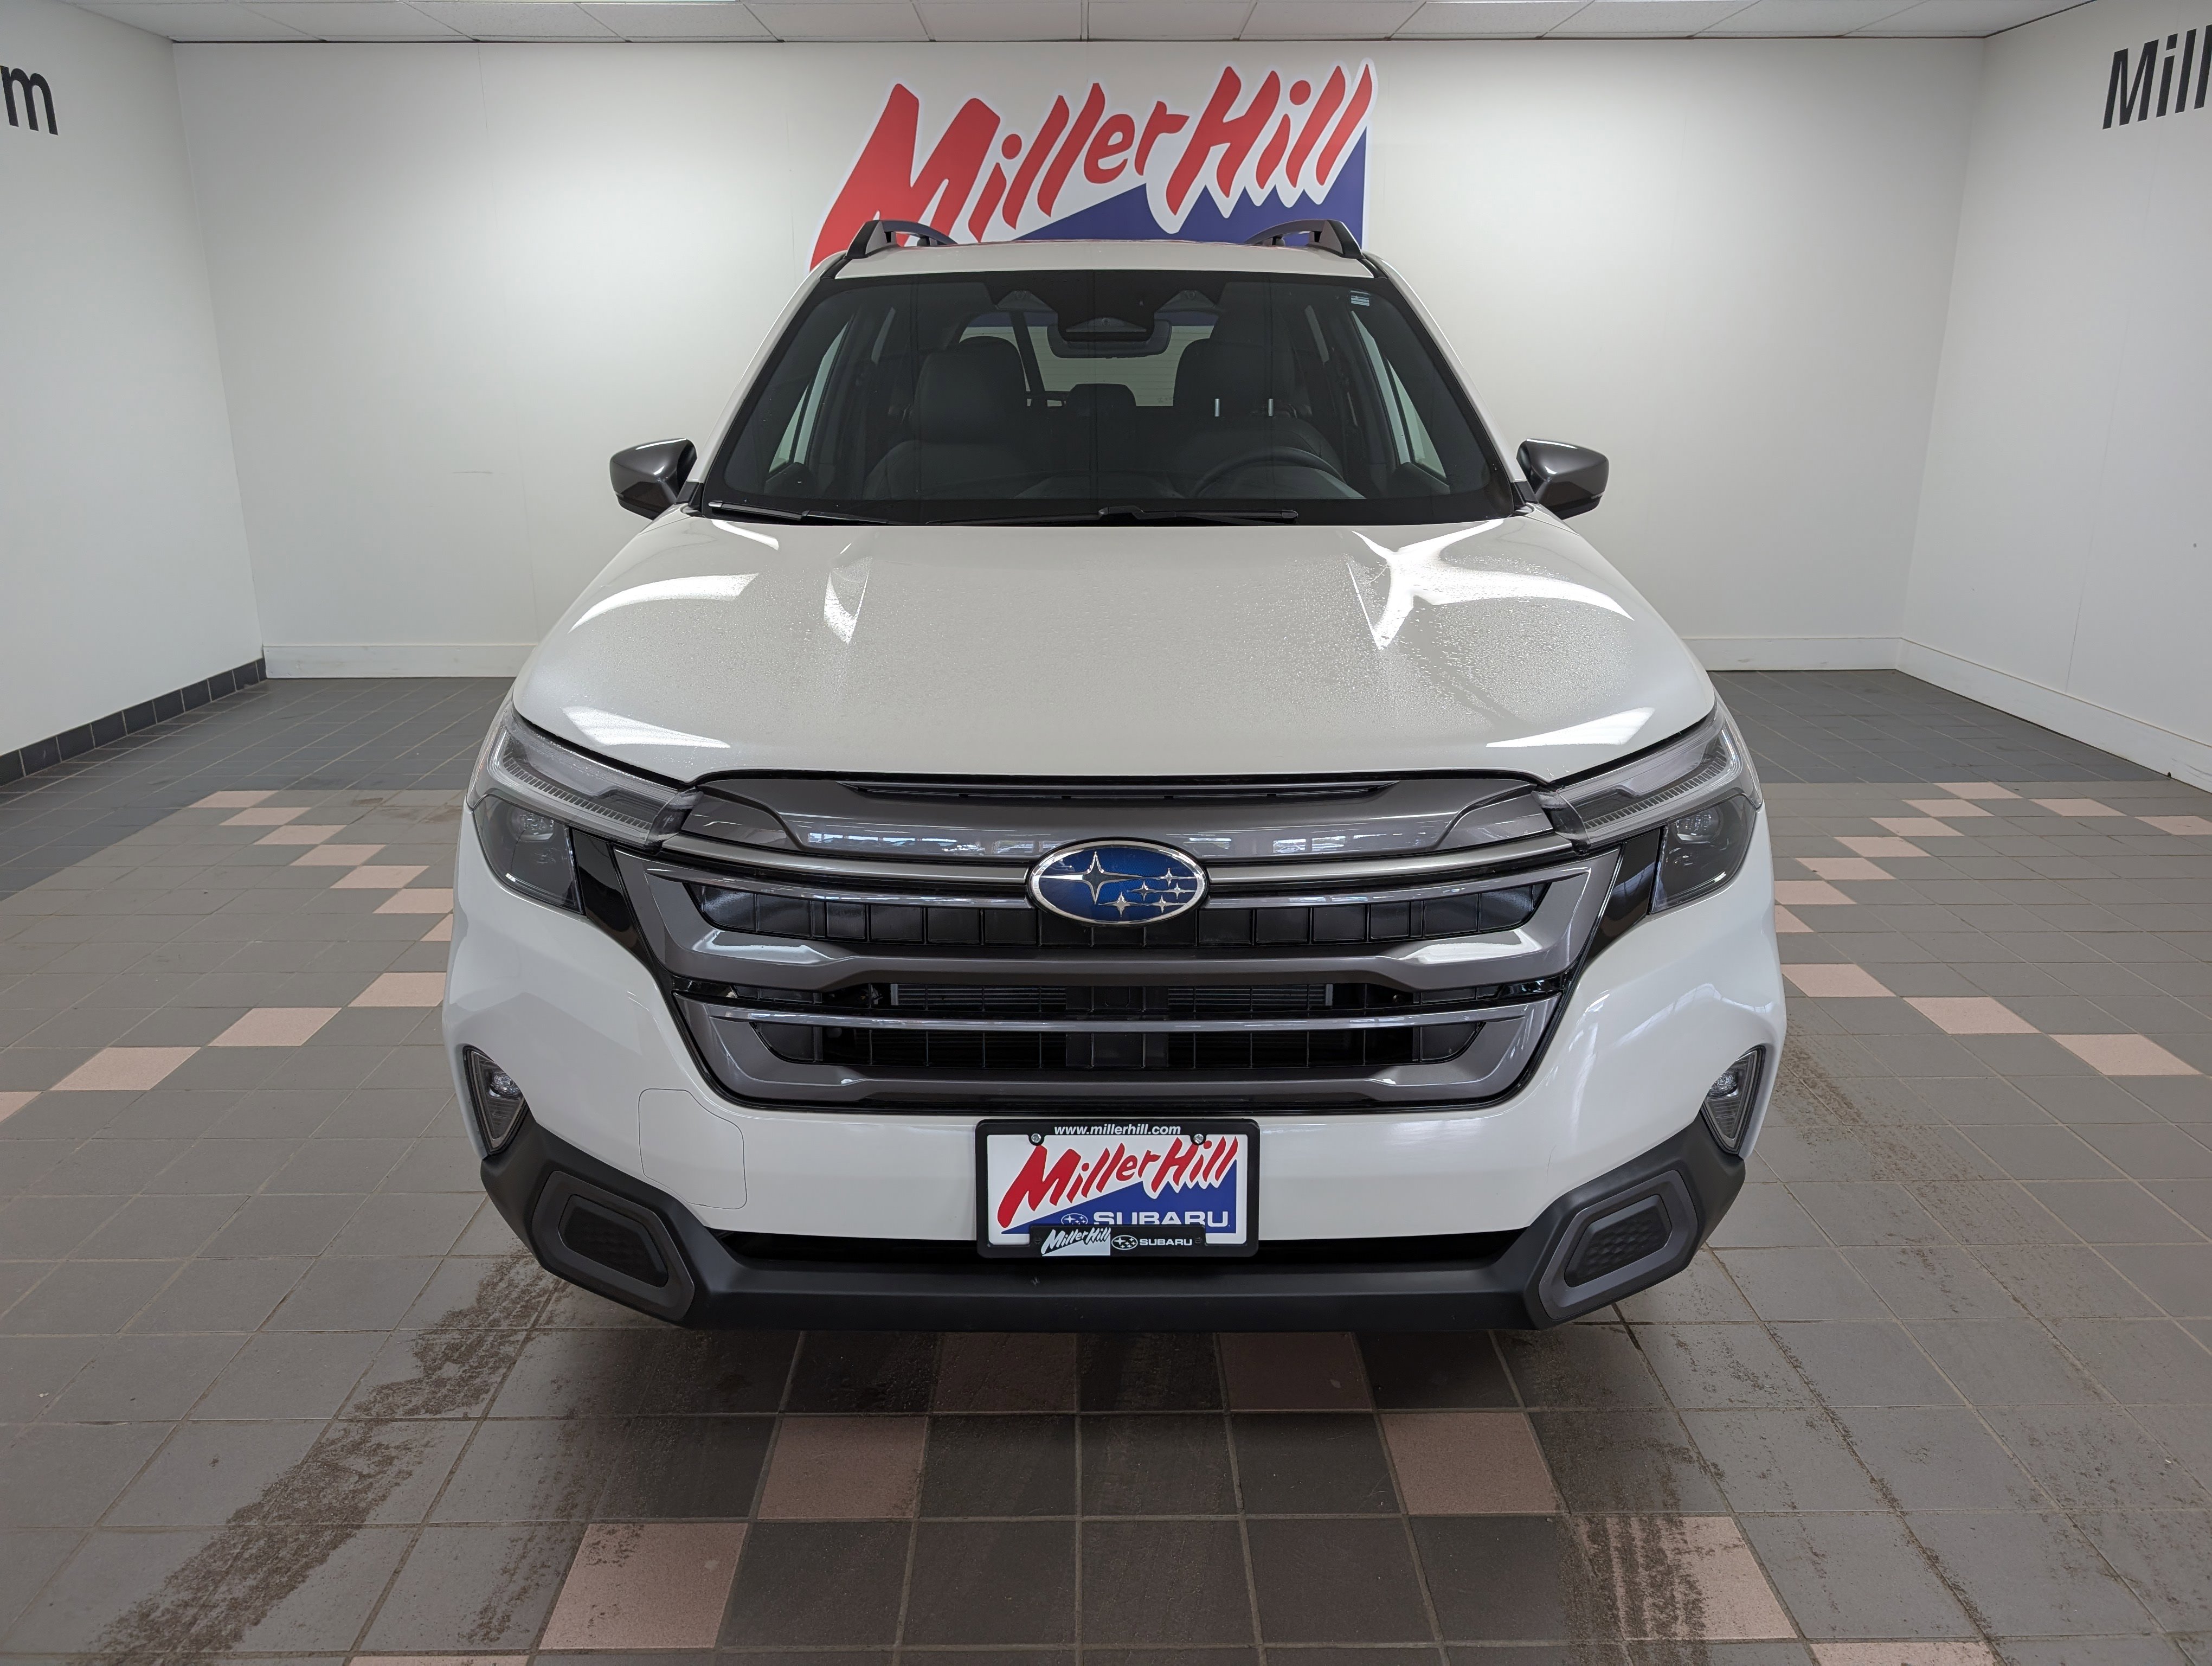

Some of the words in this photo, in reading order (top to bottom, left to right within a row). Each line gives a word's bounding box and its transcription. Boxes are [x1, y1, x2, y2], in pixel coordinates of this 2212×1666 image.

[810, 82, 1189, 271] Miller
[1166, 63, 1372, 216] Hill
[1054, 1123, 1181, 1135] www.millerhill.com
[997, 1143, 1161, 1228] Miller
[1151, 1136, 1238, 1193] Hill
[1093, 1211, 1229, 1227] SUBARU
[1041, 1229, 1089, 1255] Miller
[1086, 1227, 1111, 1245] Hill
